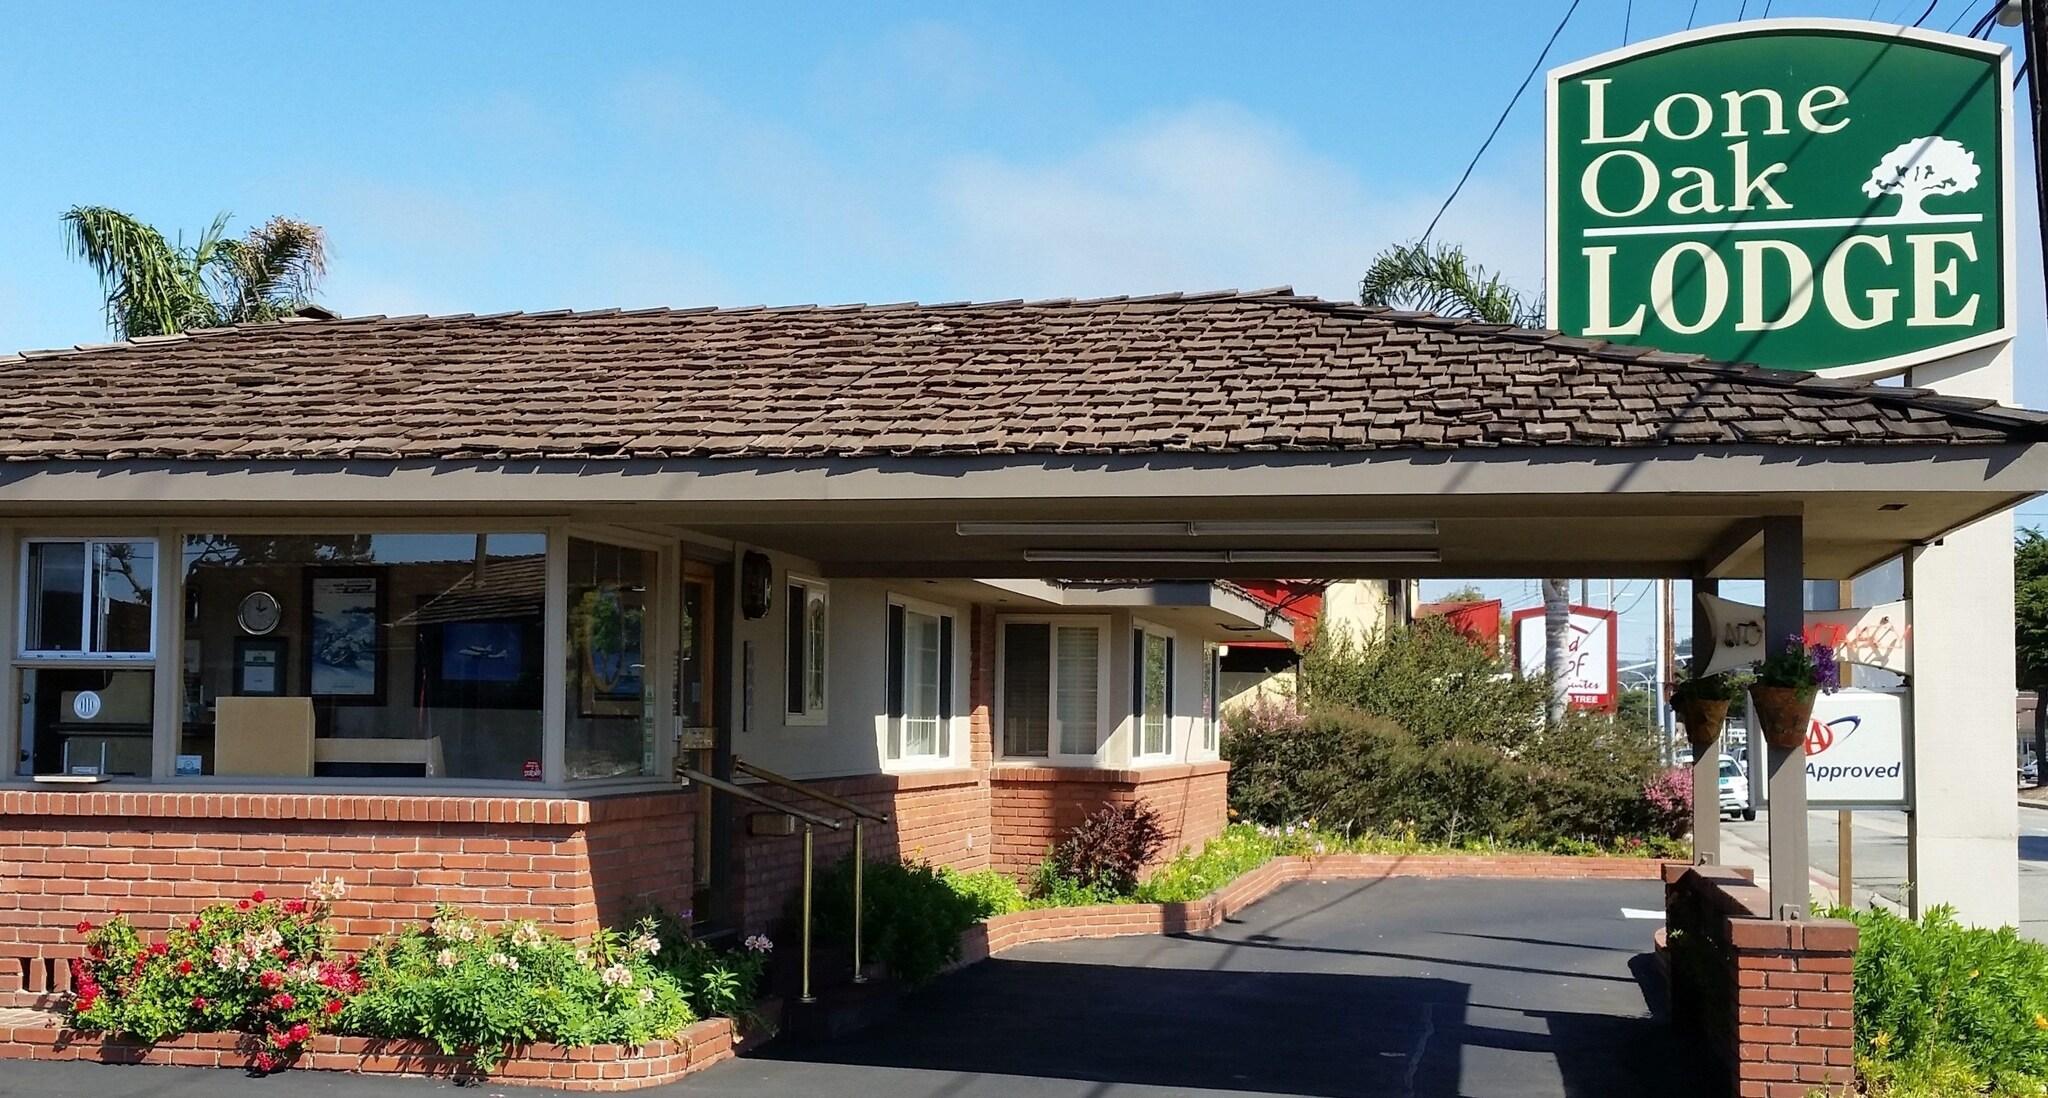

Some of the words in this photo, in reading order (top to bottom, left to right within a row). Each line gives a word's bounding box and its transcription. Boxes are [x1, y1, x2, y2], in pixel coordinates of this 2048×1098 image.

[1581, 78, 1851, 144] Lone
[1581, 141, 1793, 217] Oak
[1582, 231, 1980, 336] LODGE
[1806, 761, 1901, 782] Approved
